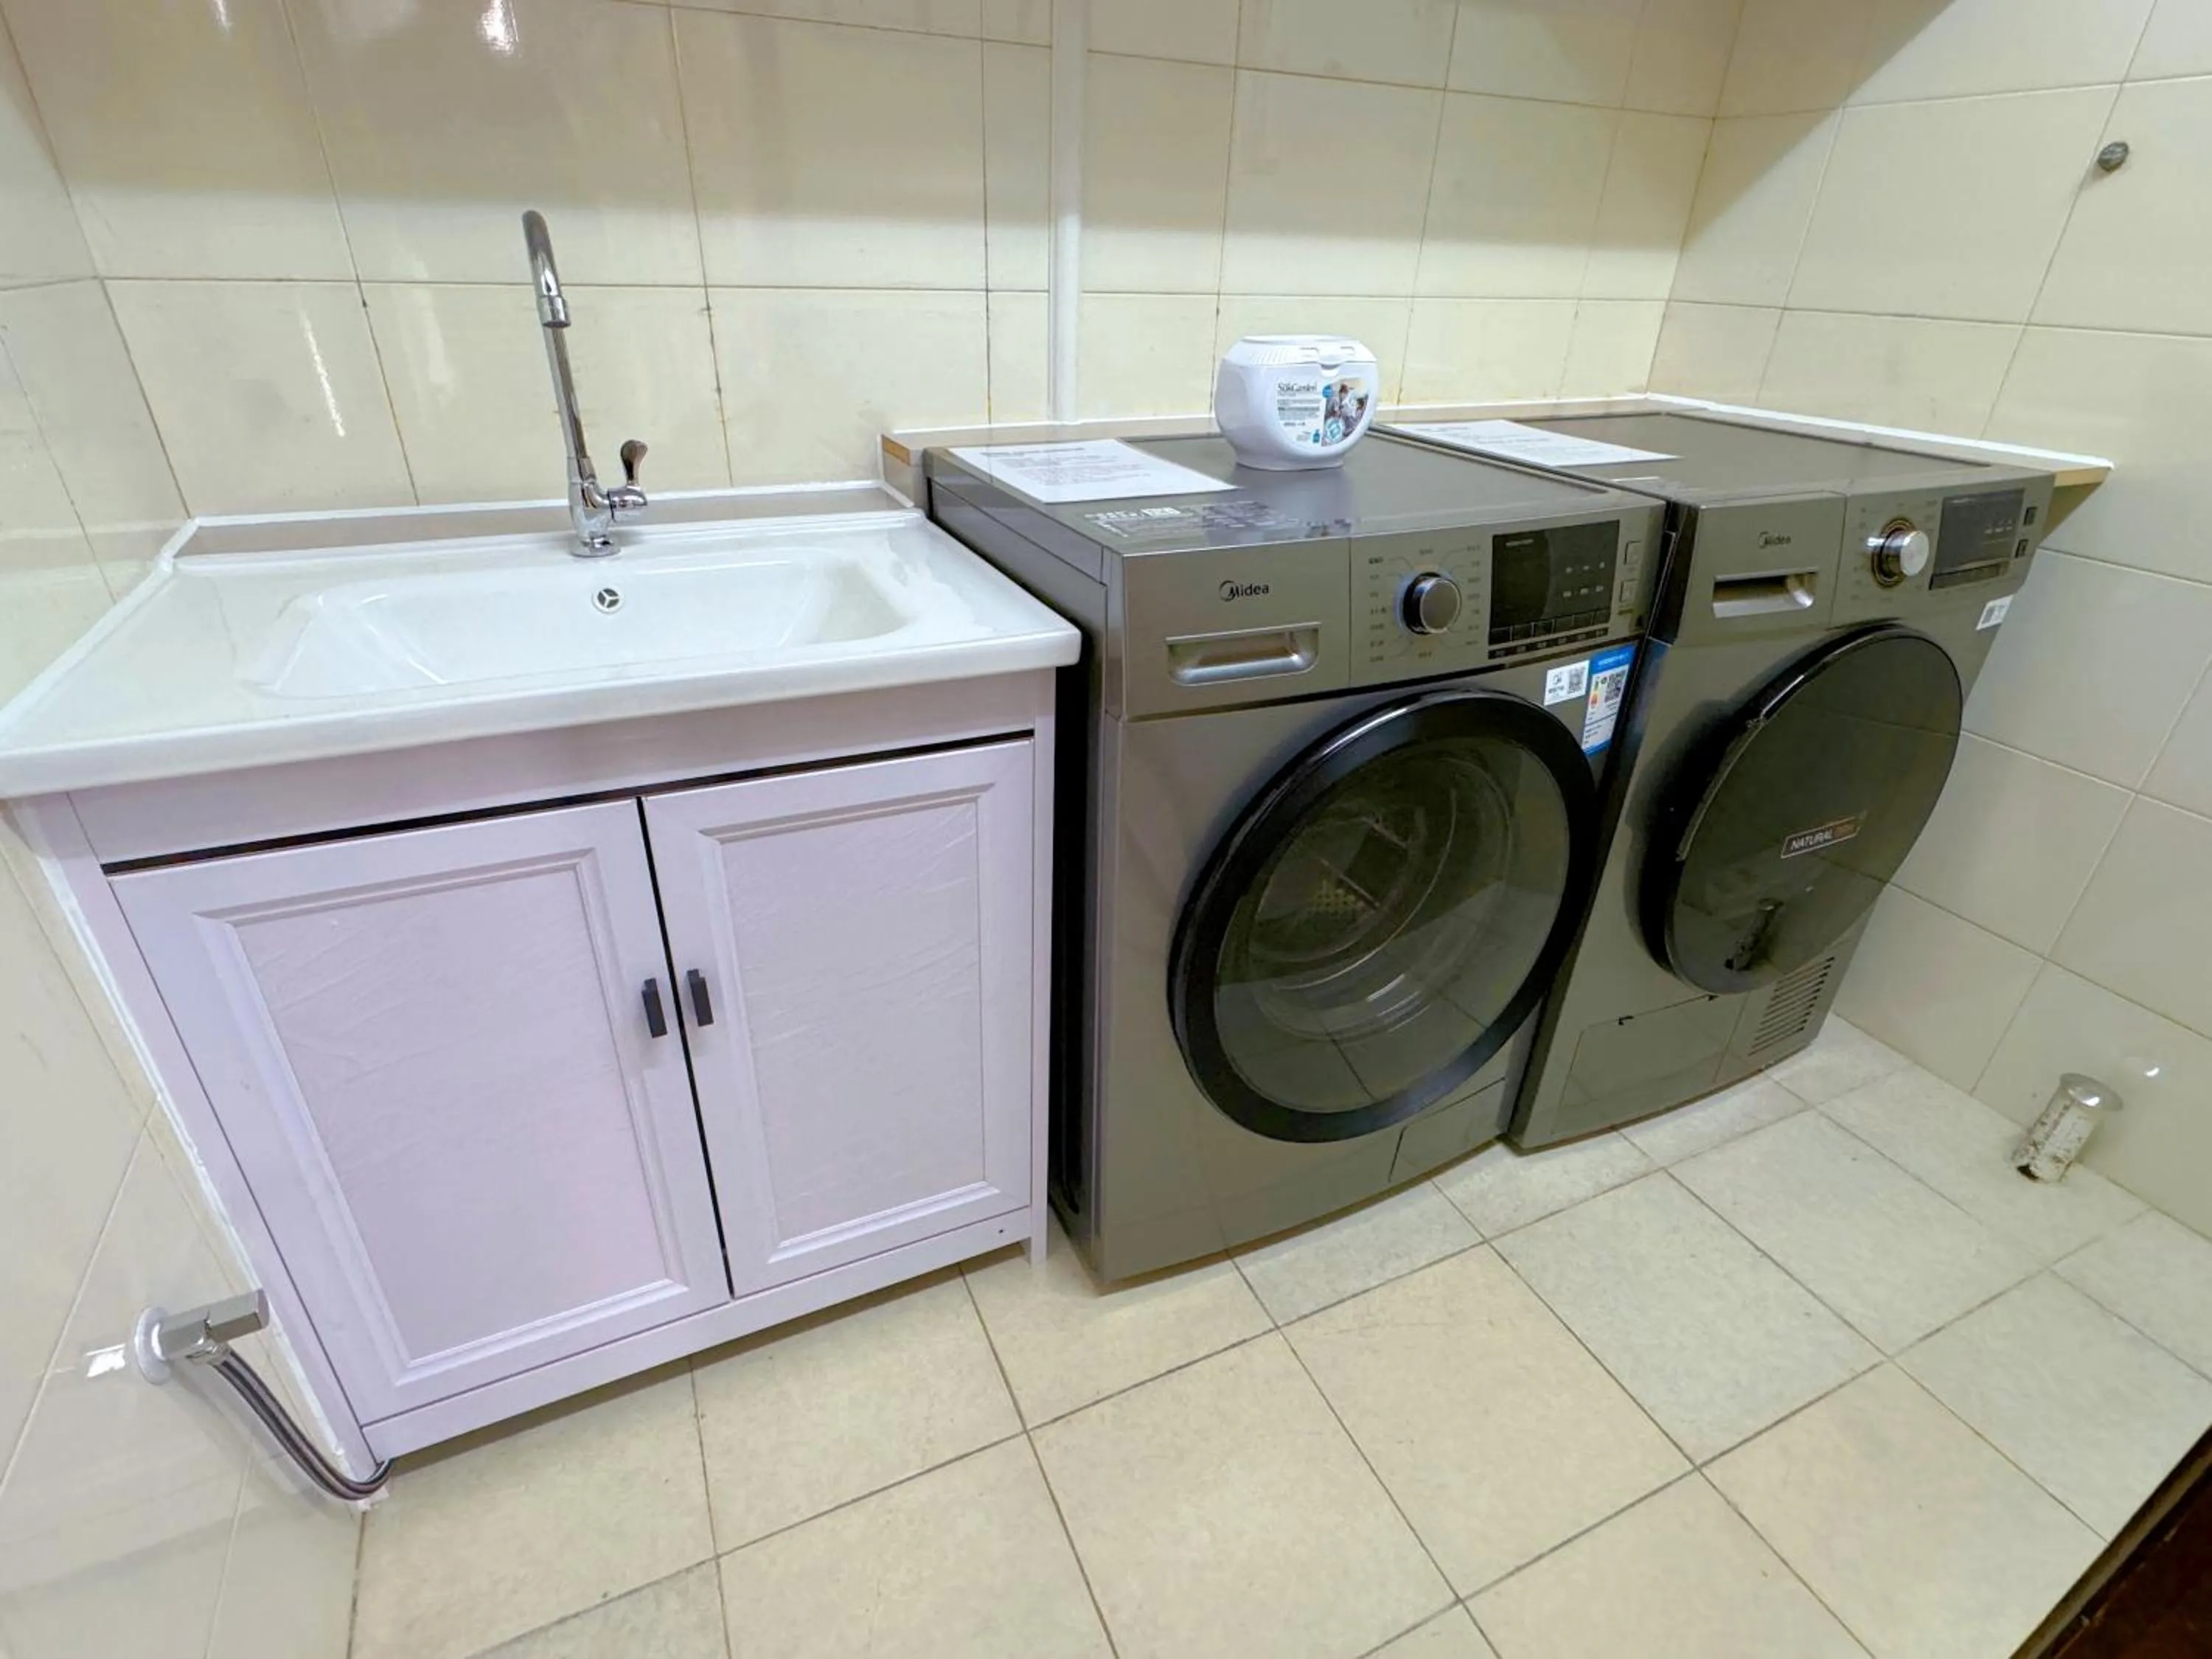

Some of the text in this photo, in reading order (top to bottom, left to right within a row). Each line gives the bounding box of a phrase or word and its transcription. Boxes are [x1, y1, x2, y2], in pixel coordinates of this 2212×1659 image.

[1758, 530, 1791, 550] Midea
[1220, 580, 1269, 602] Midea
[1790, 828, 1832, 850] NATURAL
